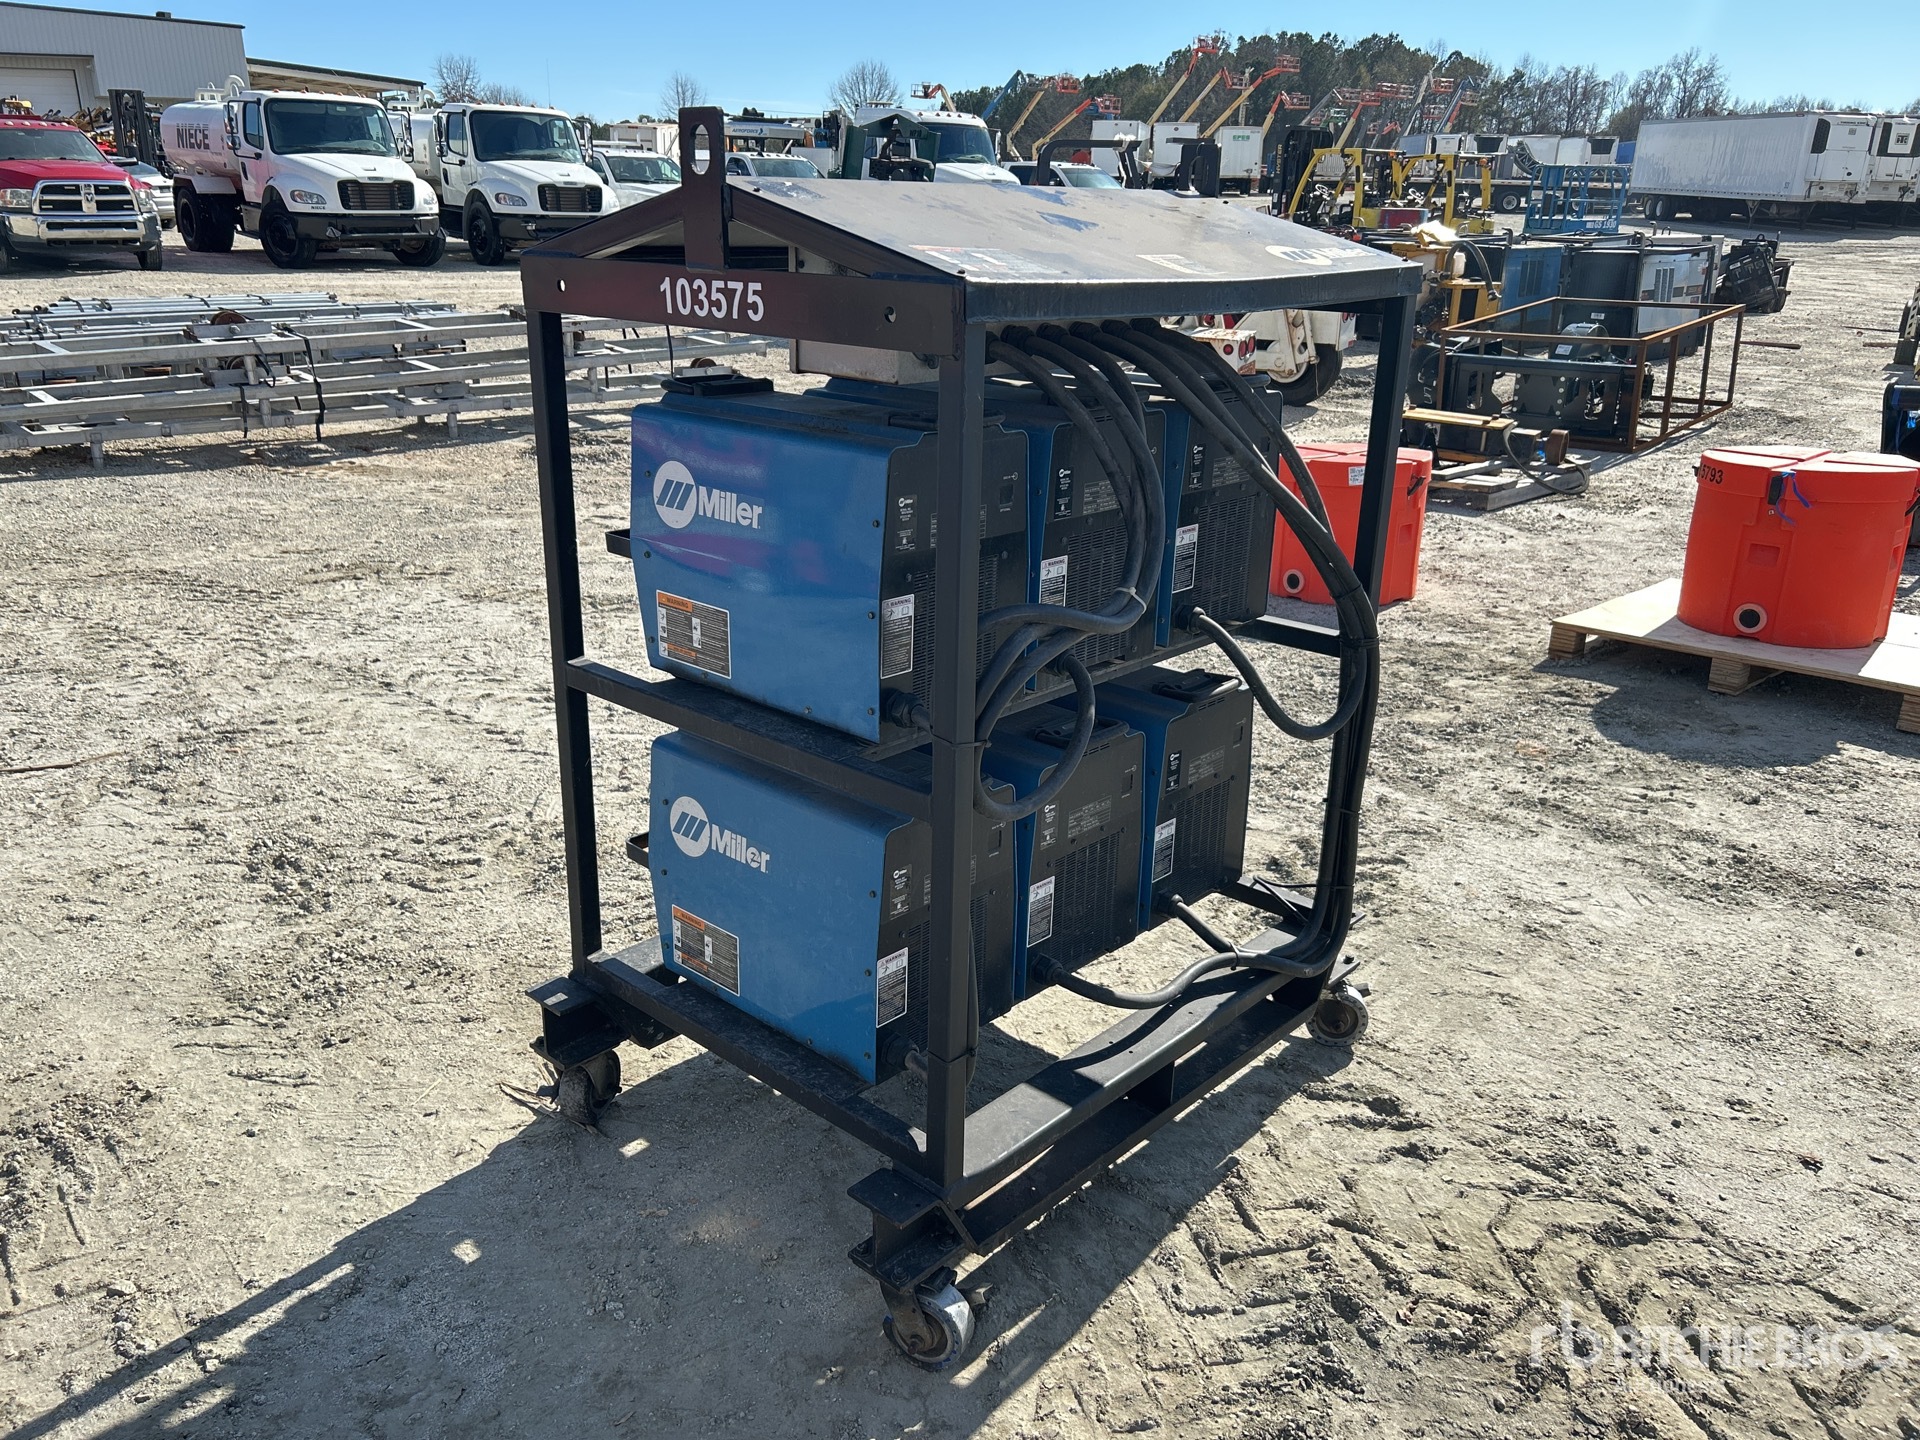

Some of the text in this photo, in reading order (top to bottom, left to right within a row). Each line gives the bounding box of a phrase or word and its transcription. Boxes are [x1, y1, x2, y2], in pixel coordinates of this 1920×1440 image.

[660, 276, 765, 322] 103575
[698, 485, 763, 529] Miller
[711, 823, 770, 873] Miller
